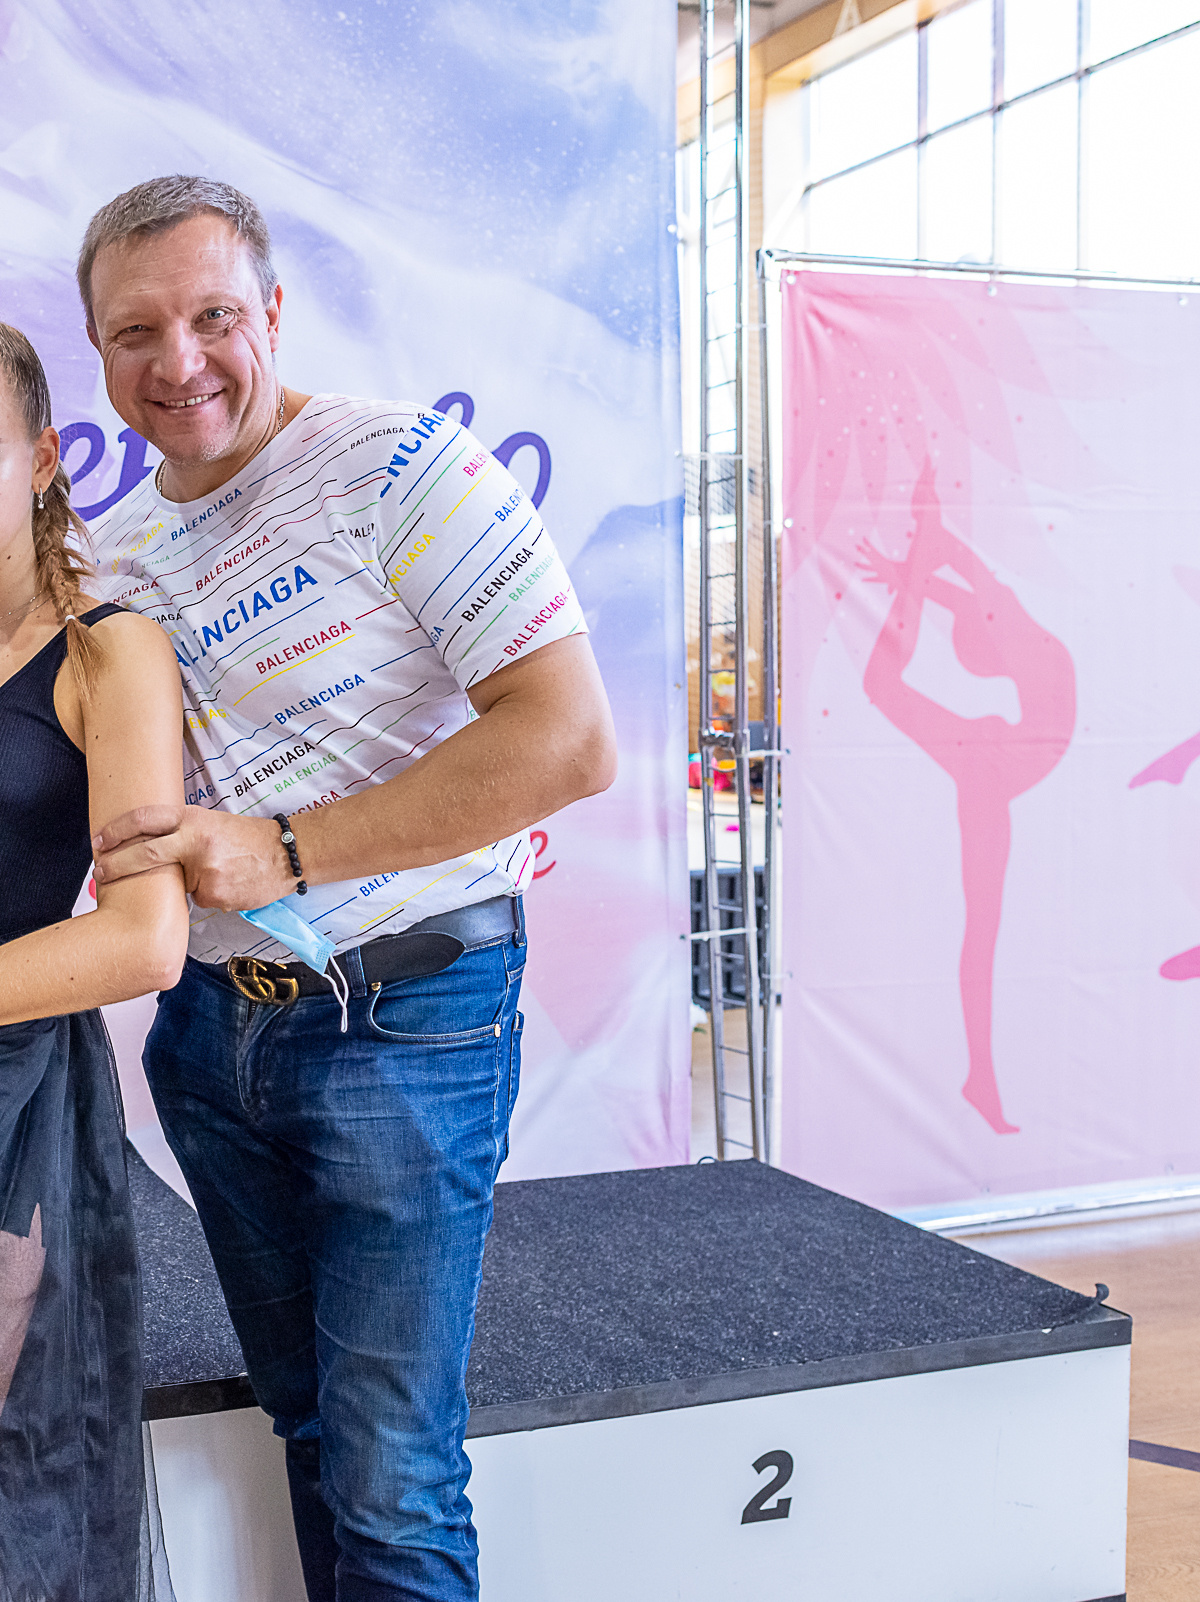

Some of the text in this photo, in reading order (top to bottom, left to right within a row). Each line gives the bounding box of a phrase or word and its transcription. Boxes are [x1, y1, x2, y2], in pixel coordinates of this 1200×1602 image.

[350, 426, 405, 450] BALENCIAGA
[170, 488, 242, 541] BALENCIAGA
[111, 522, 164, 574] BALNCIAGA
[195, 534, 270, 592] BALENCIAGA
[108, 580, 160, 605] NCIAGA
[461, 547, 534, 623] BALENCIAGA
[508, 552, 556, 603] BALENCIAGA
[255, 620, 352, 675] BALENCIAGA
[503, 593, 568, 657] BALENCIAGA
[274, 673, 366, 725] BALENCIAGA
[234, 741, 316, 797] BALENCIAGA
[274, 752, 340, 793] BALENCIAG
[740, 1449, 794, 1526] 2
